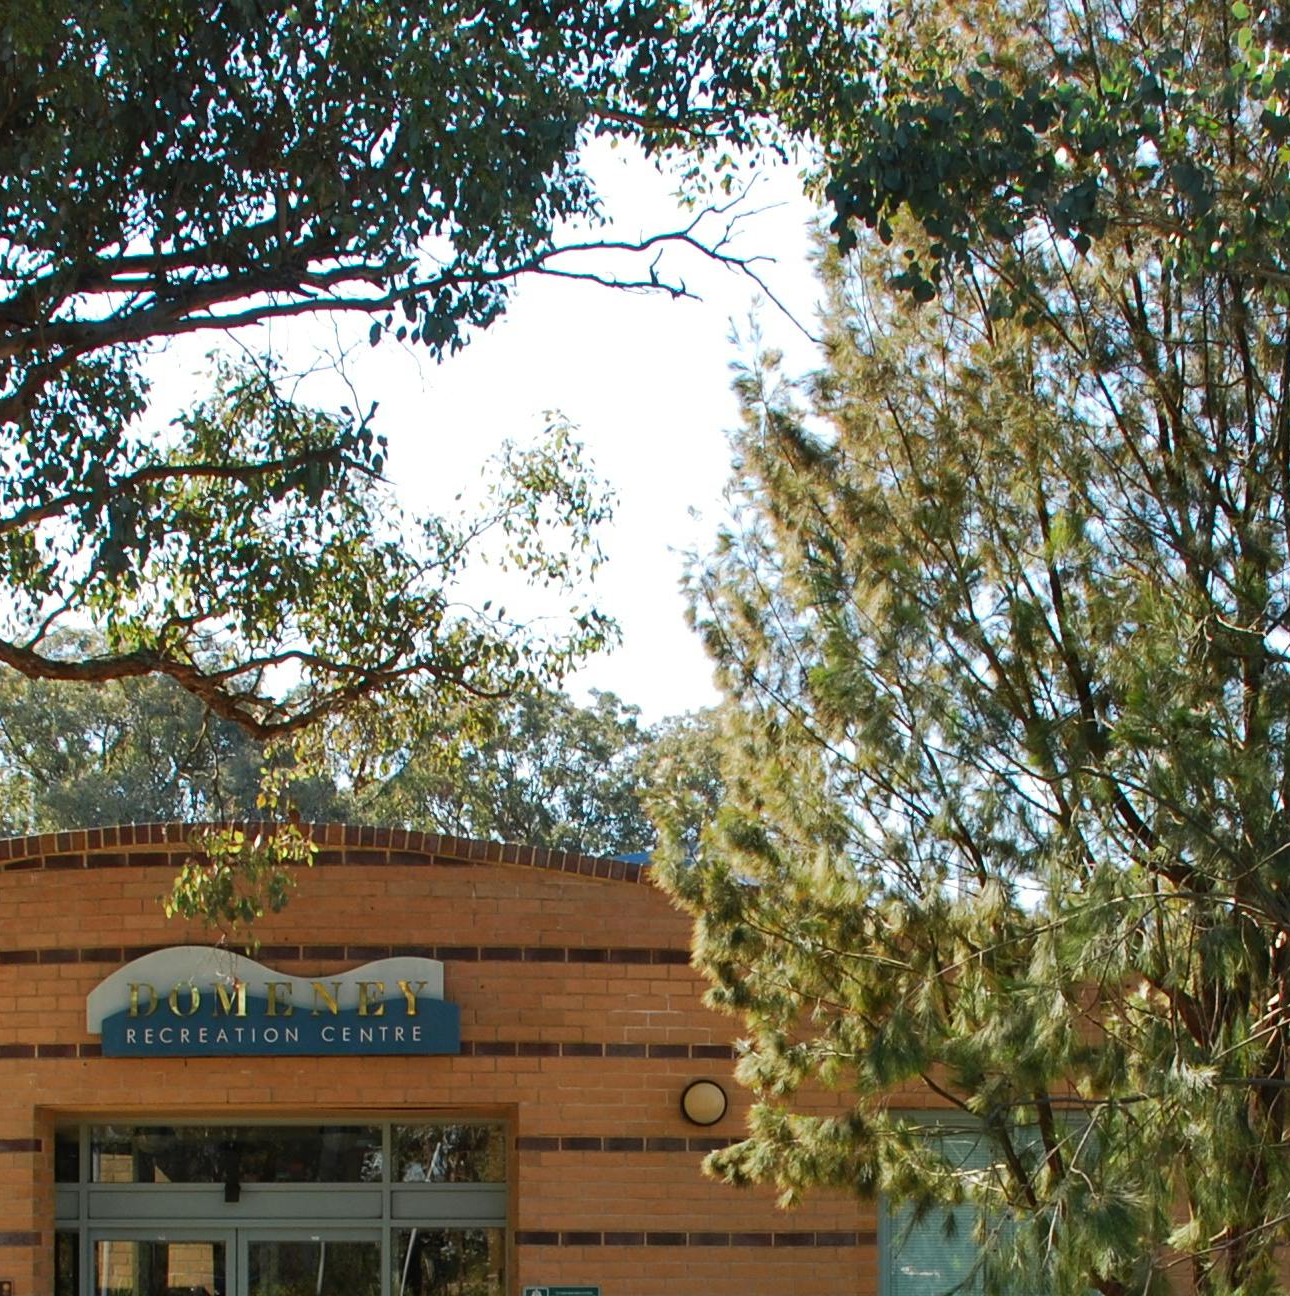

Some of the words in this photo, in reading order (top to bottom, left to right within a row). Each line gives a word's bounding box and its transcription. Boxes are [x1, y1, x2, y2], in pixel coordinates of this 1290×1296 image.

[126, 979, 429, 1018] DOMENEY
[126, 1026, 299, 1044] RECREATION
[321, 1025, 423, 1043] CENTRE
